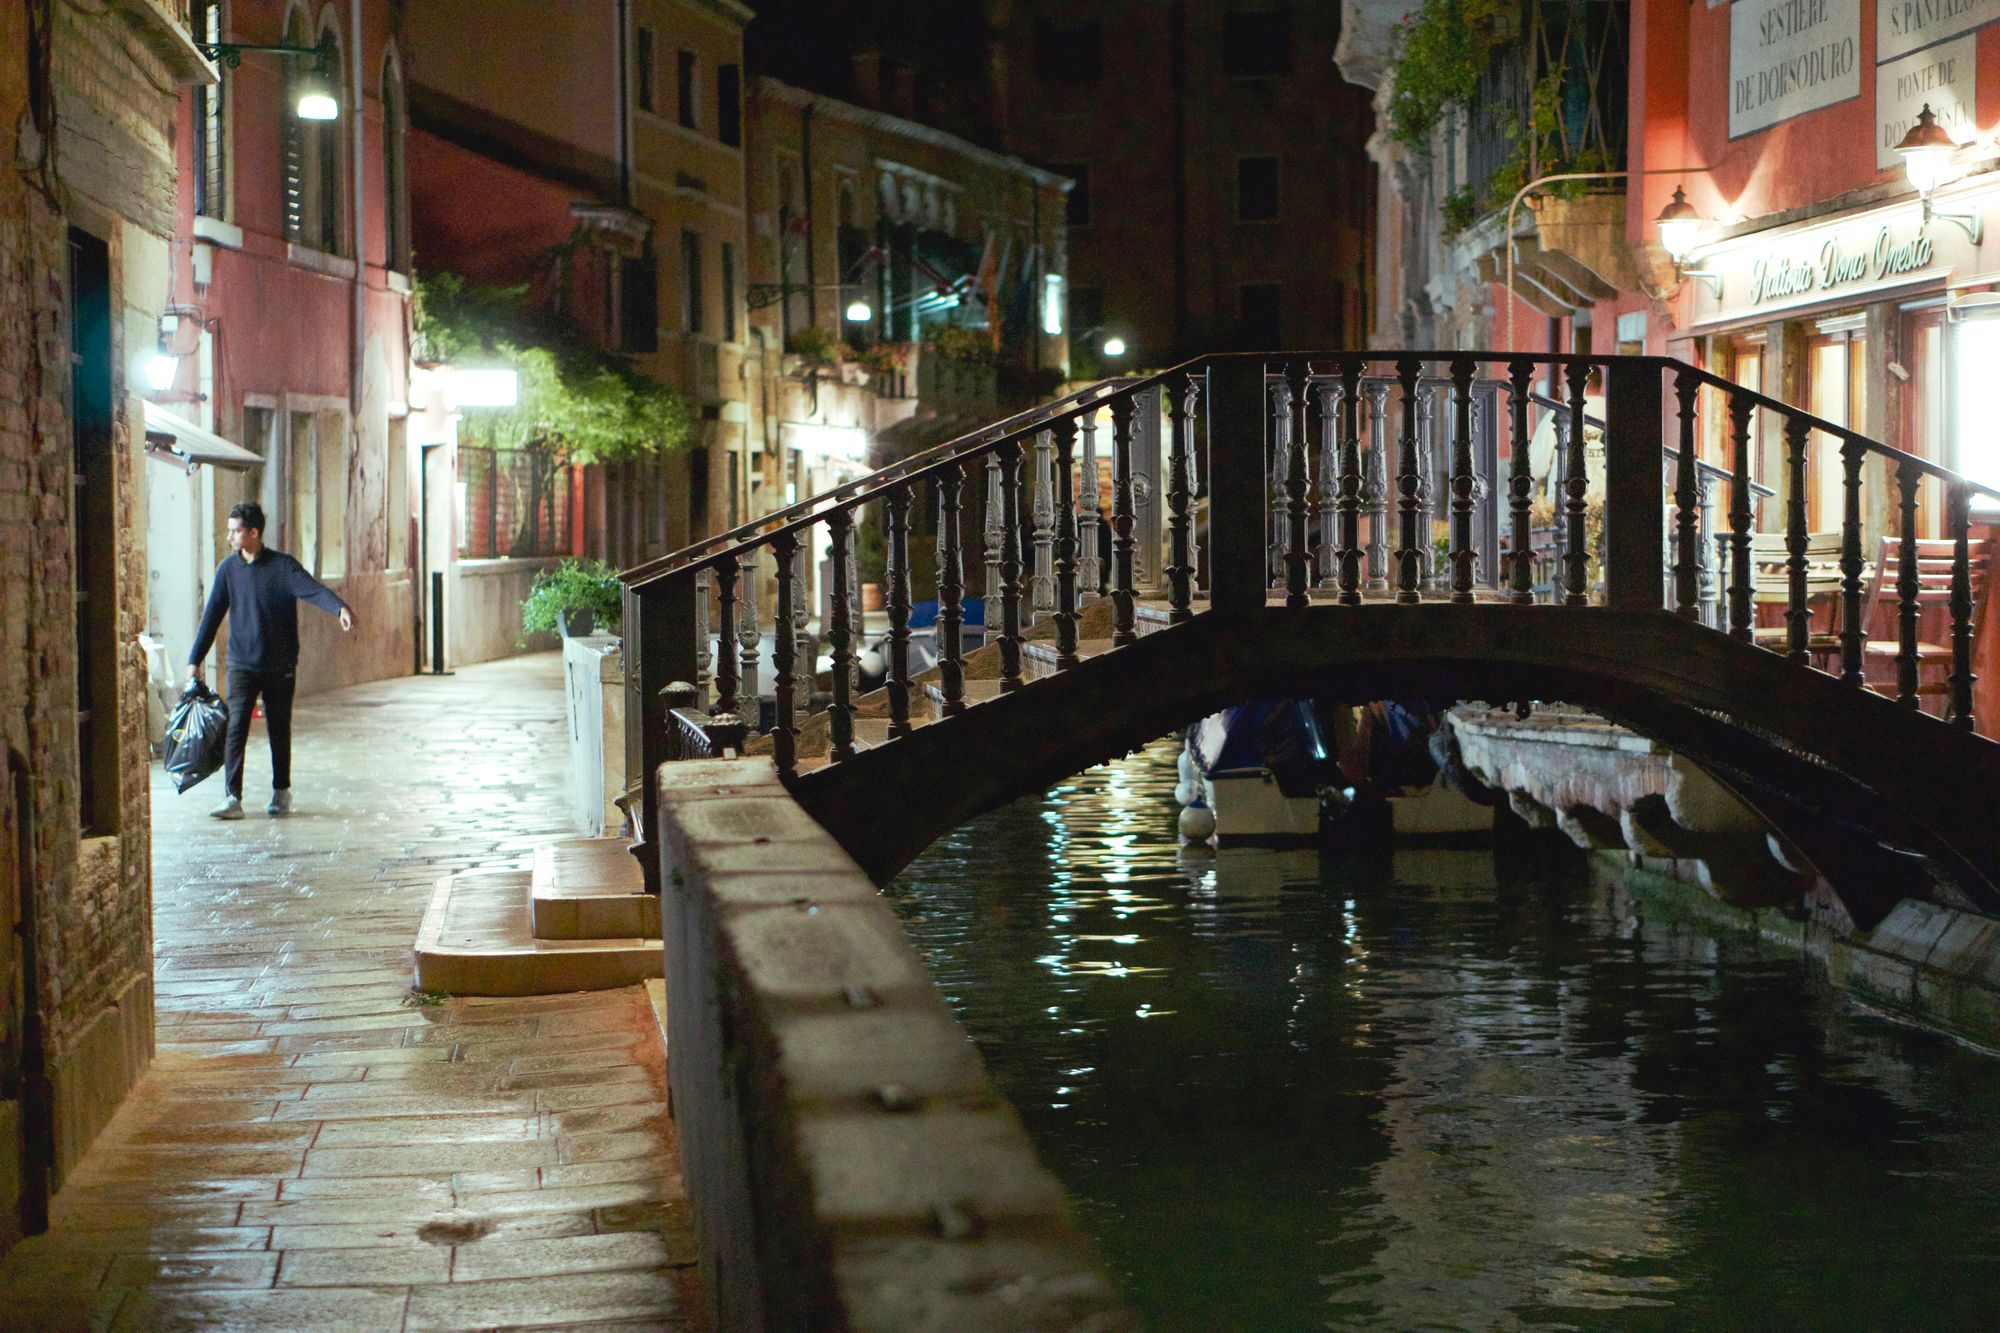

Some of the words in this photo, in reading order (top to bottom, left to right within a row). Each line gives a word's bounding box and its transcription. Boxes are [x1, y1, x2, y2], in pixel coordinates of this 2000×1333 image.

[1759, 0, 1828, 47] SESTIERE
[1736, 74, 1755, 114] DE
[1758, 37, 1854, 106] DORSODURO
[1896, 64, 1934, 102] PONTE
[1938, 58, 1956, 87] DE
[1751, 254, 1813, 306] Trattoria
[1819, 235, 1867, 290] Dona
[1873, 225, 1933, 281] Onesta
